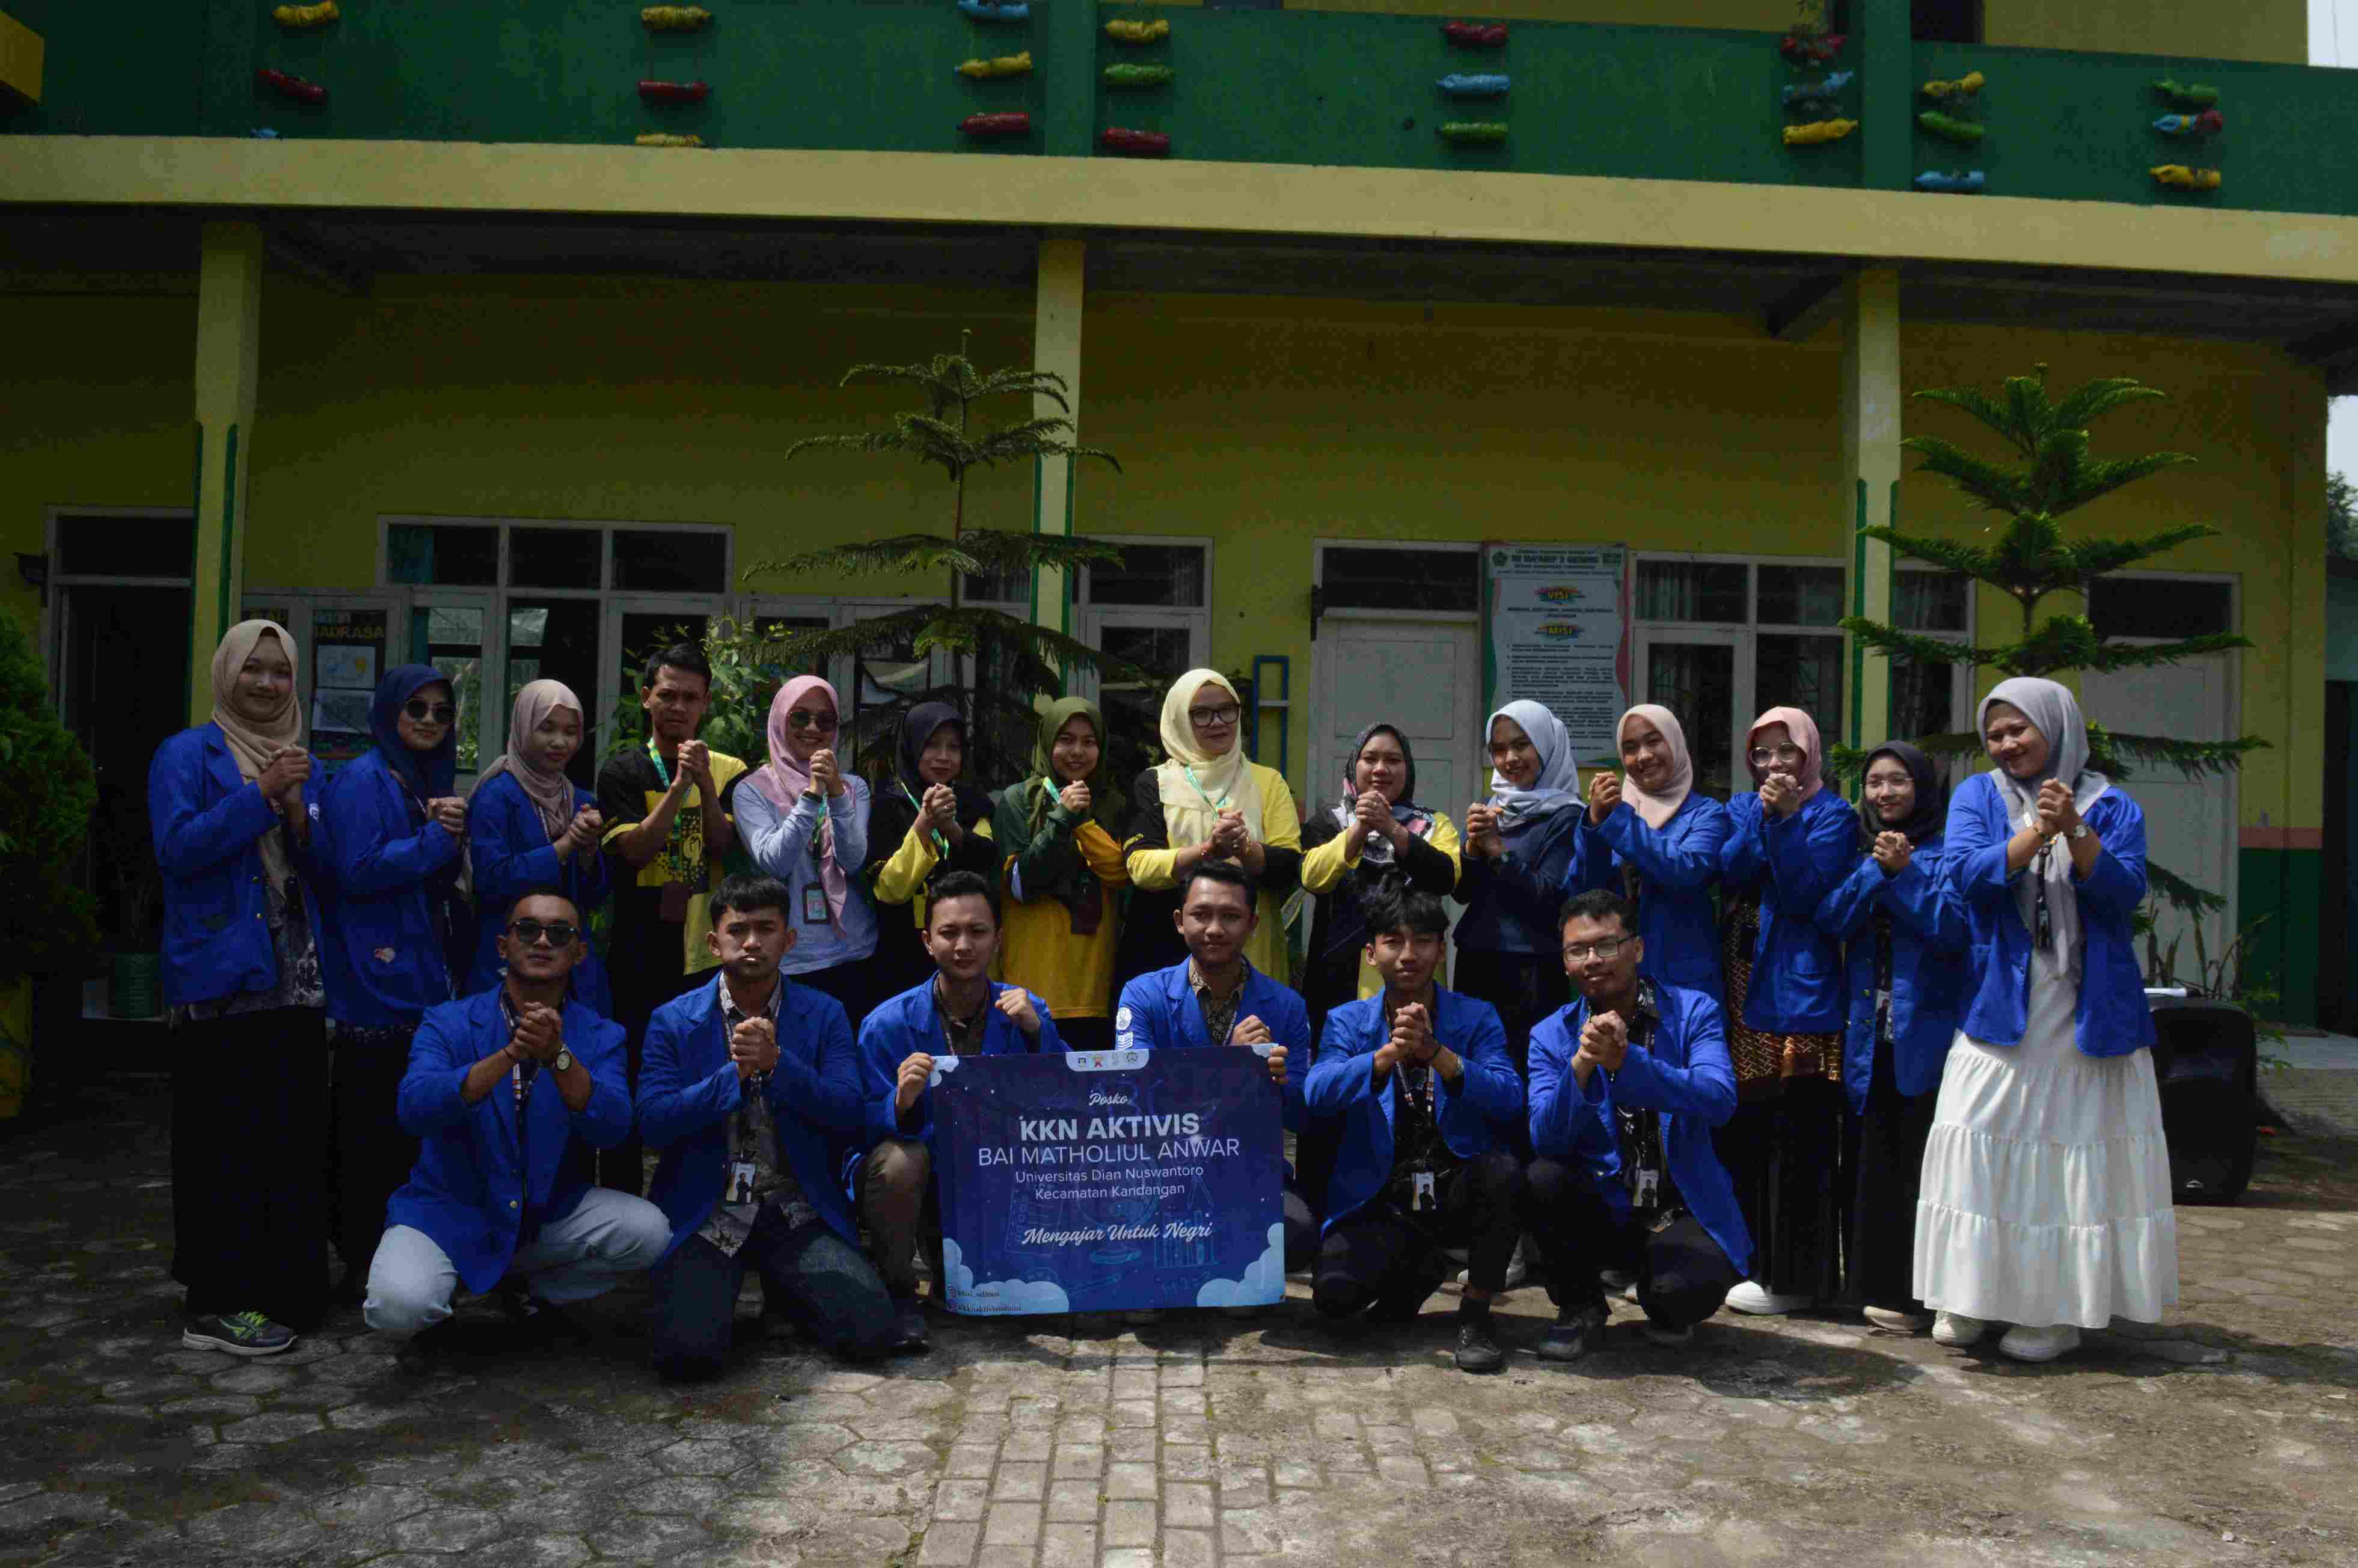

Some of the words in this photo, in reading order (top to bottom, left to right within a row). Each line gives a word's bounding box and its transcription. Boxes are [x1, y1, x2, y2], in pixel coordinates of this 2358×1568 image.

[1548, 590, 1569, 600] VISI
[1548, 626, 1573, 636] MISI
[1088, 1092, 1128, 1106] Posko
[1020, 1118, 1078, 1141] KKN
[1086, 1112, 1200, 1140] AKTIVIS
[978, 1147, 1013, 1166] BAI
[1021, 1143, 1151, 1165] MATHOLIUL
[1157, 1138, 1240, 1160] ANWAR
[1015, 1171, 1087, 1183] Universitas
[1092, 1169, 1121, 1181] Dian
[1125, 1165, 1204, 1179] Nuswantoro
[1035, 1187, 1107, 1200] Kecamatan
[1112, 1183, 1185, 1199] Kandangan
[1021, 1226, 1106, 1246] Mengajar
[1106, 1223, 1160, 1241] Untuk
[1163, 1221, 1213, 1242] Negri
